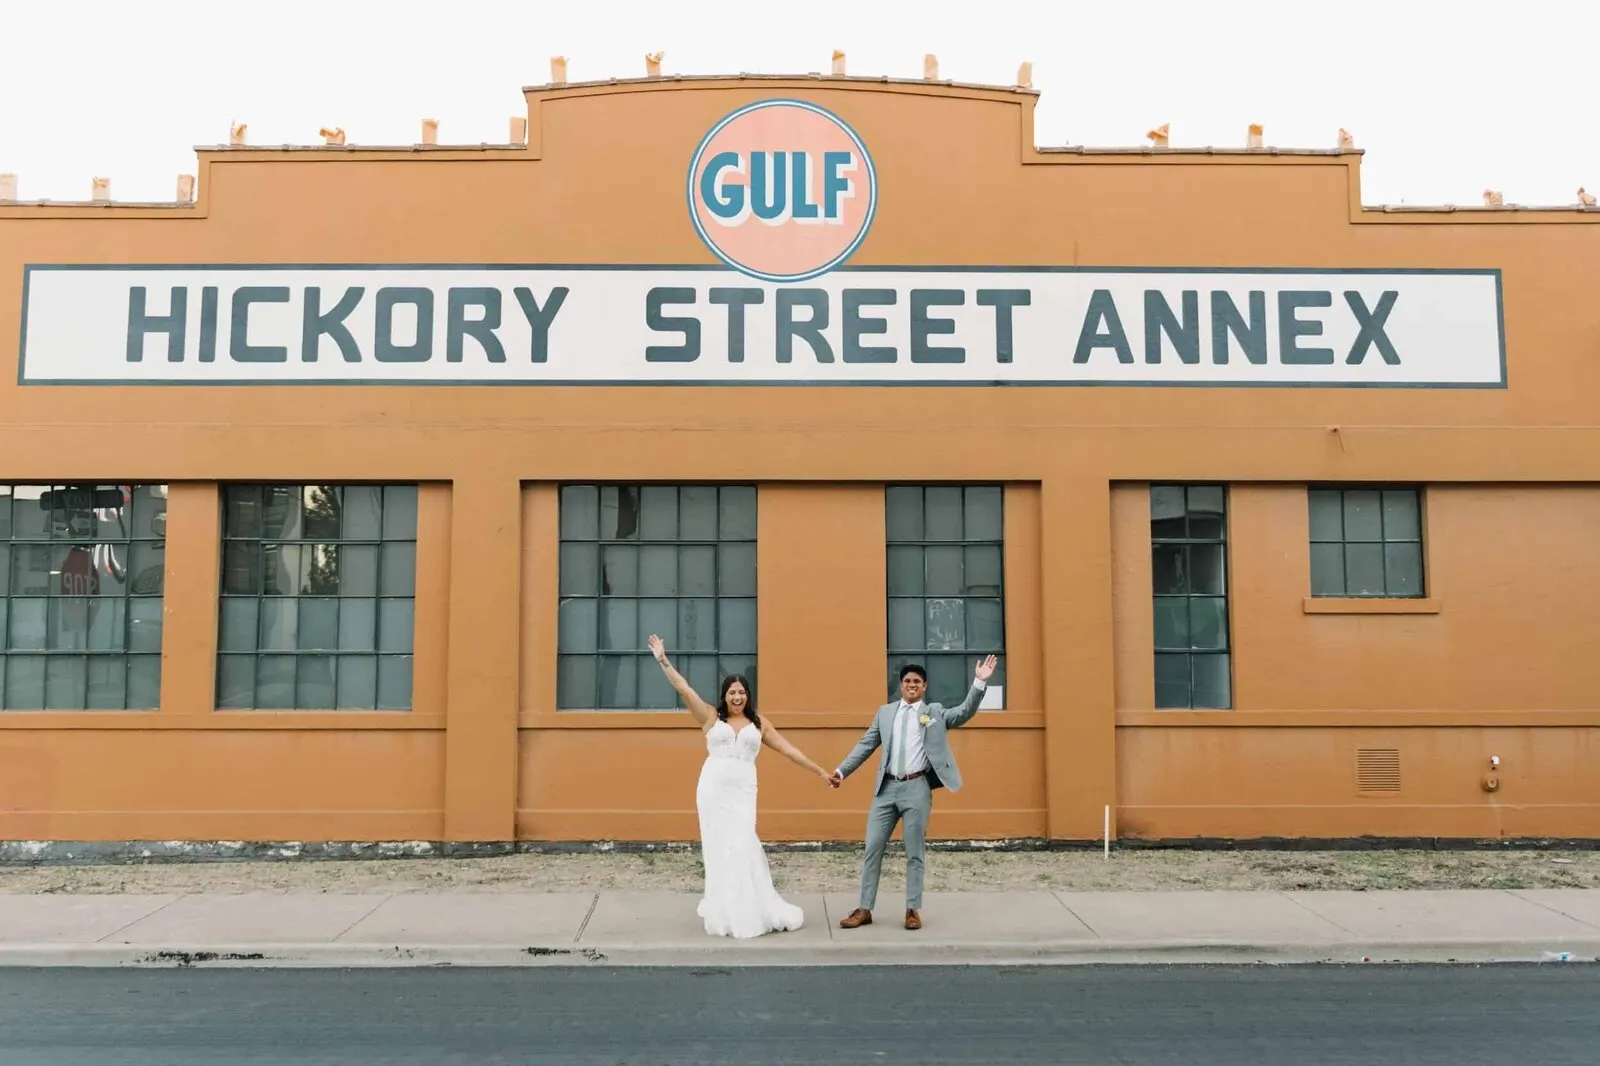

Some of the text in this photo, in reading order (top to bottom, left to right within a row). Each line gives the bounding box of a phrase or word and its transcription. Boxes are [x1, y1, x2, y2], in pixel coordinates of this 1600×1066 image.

[701, 151, 857, 227] GULF
[126, 286, 1402, 366] HICKORY STREET ANNEX
